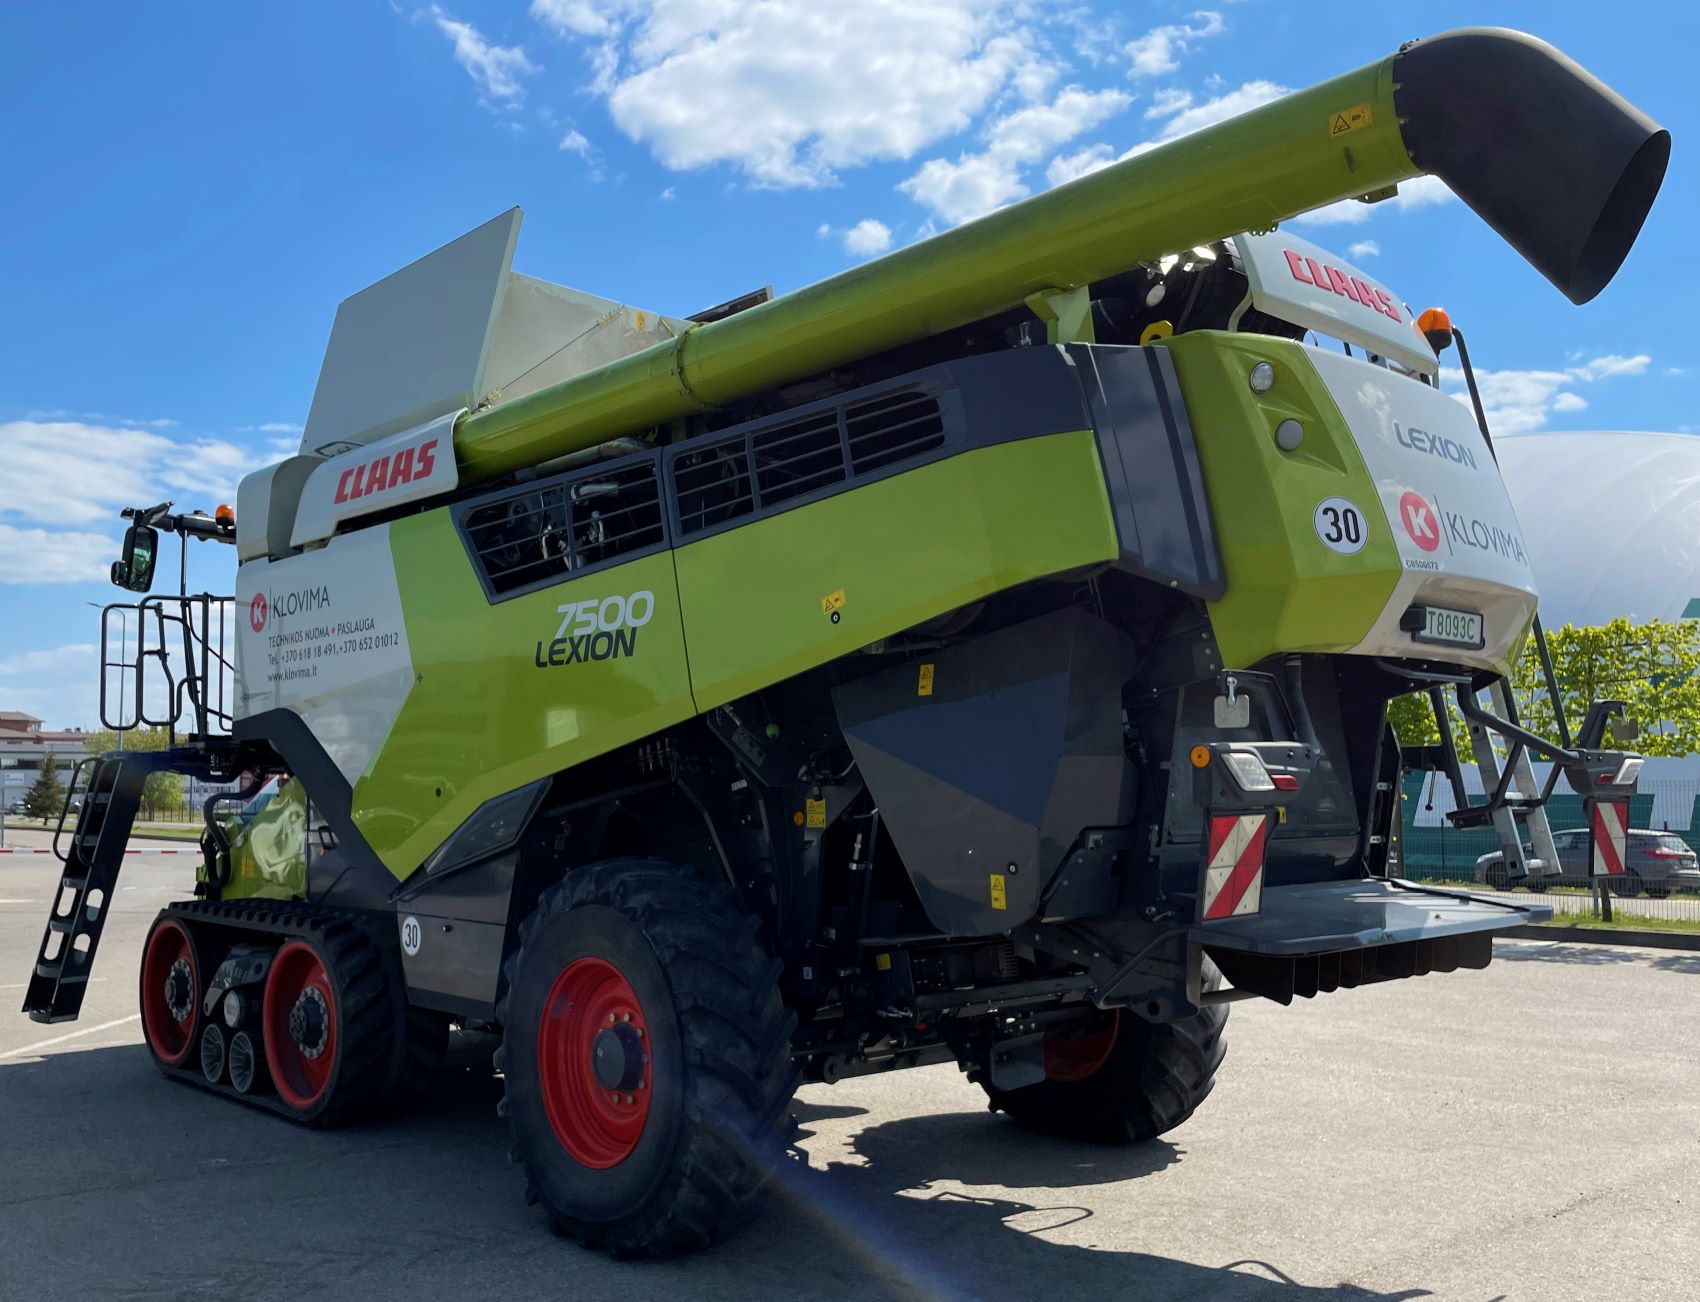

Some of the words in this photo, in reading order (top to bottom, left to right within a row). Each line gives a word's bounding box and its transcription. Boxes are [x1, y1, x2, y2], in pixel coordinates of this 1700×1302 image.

[1282, 249, 1402, 323] CLAAS
[1393, 421, 1477, 470] LEXION
[334, 439, 439, 504] CLAAS
[1322, 507, 1360, 543] 30
[1407, 505, 1434, 538] K
[1446, 511, 1527, 566] KLOVIMA
[253, 602, 264, 624] K
[273, 585, 330, 619] KLOVIMA
[555, 590, 654, 639] 7500
[268, 630, 304, 648] TECHNIKOS
[305, 626, 330, 642] NUOMA
[337, 618, 375, 636] PASLAUGA
[299, 648, 311, 660] 618
[314, 646, 322, 658] 18
[358, 638, 373, 651] 652
[375, 632, 399, 648] 01012
[535, 627, 636, 668] LEXION
[267, 666, 318, 683] www.klovima.lt
[405, 923, 418, 948] 30
